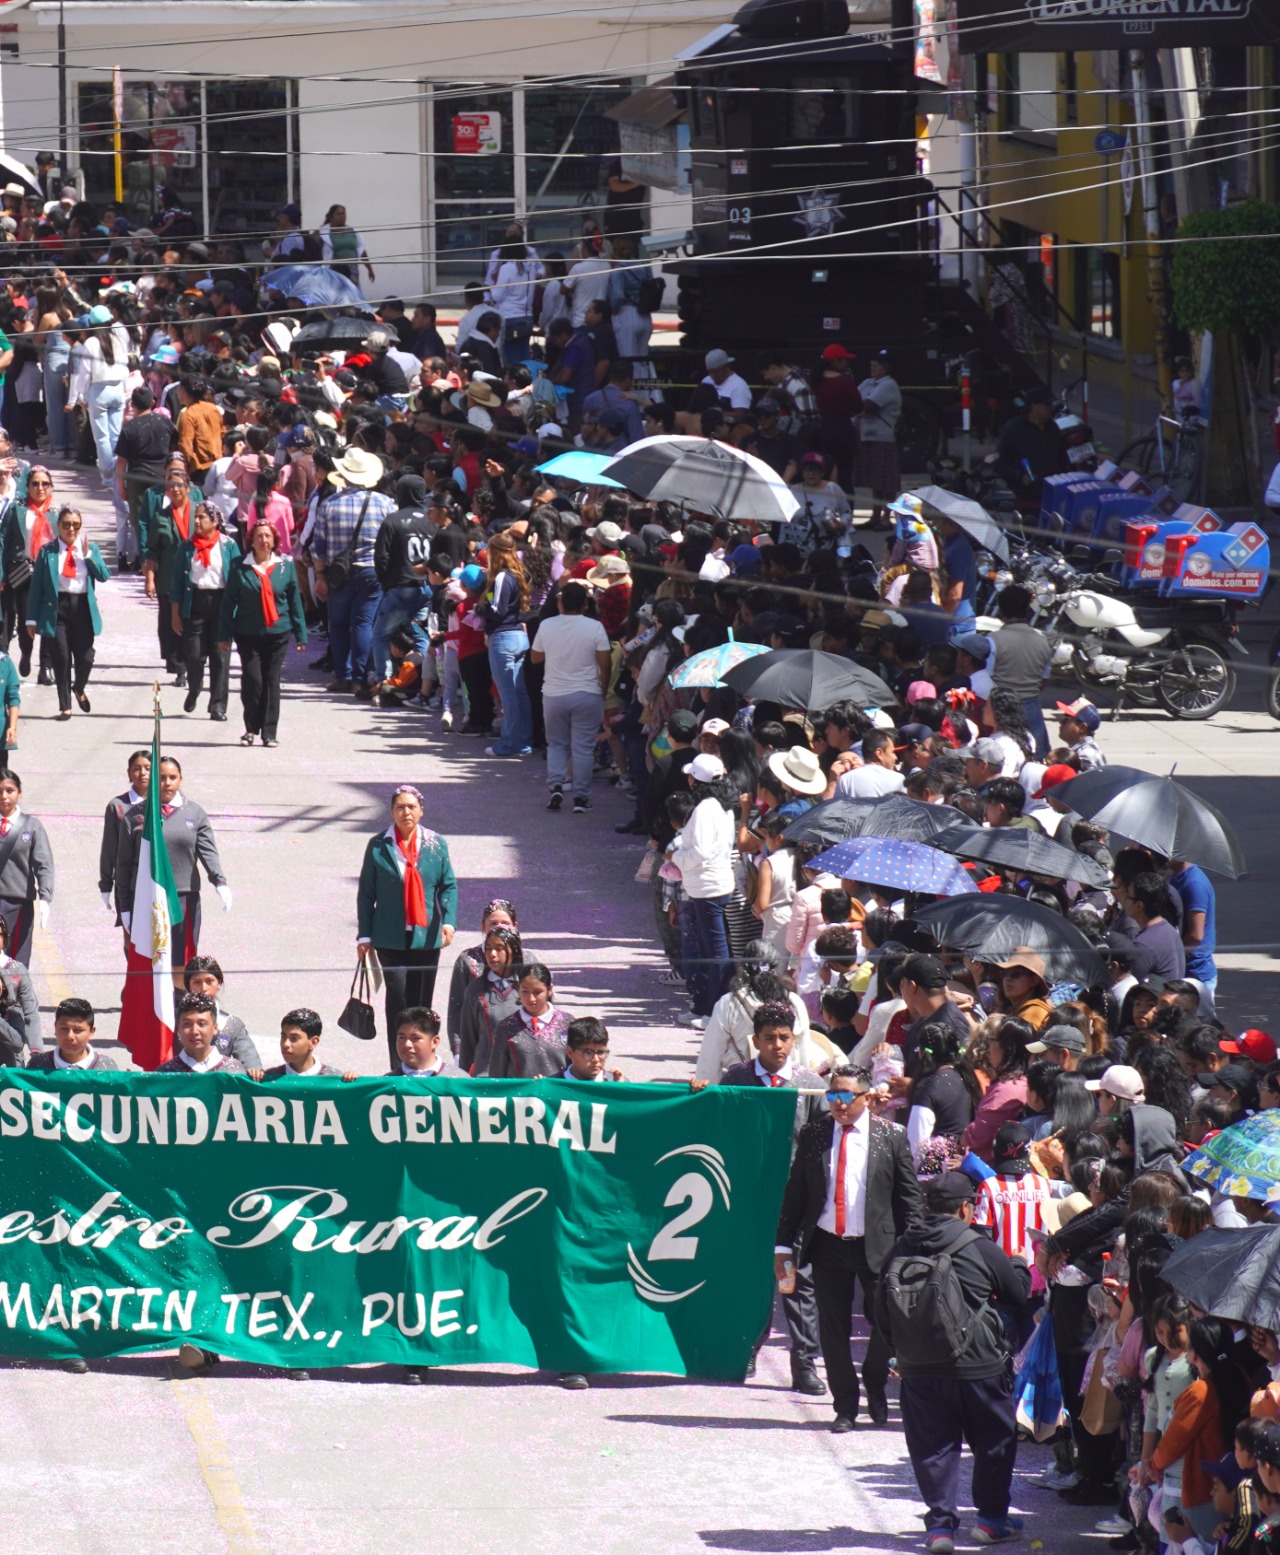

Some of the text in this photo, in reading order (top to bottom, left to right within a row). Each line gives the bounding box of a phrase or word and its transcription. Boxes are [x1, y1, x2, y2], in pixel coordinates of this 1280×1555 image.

[1128, 22, 1150, 31] 1933
[729, 207, 751, 224] 03
[1183, 576, 1259, 587] dominos.com.mx
[0, 1087, 349, 1146] SECUNDARIA
[368, 1093, 617, 1155] GENERAL
[205, 1184, 549, 1254] Rural
[647, 1171, 714, 1261] 2
[221, 1290, 344, 1349] TEX.,
[361, 1288, 480, 1338] PUE.
